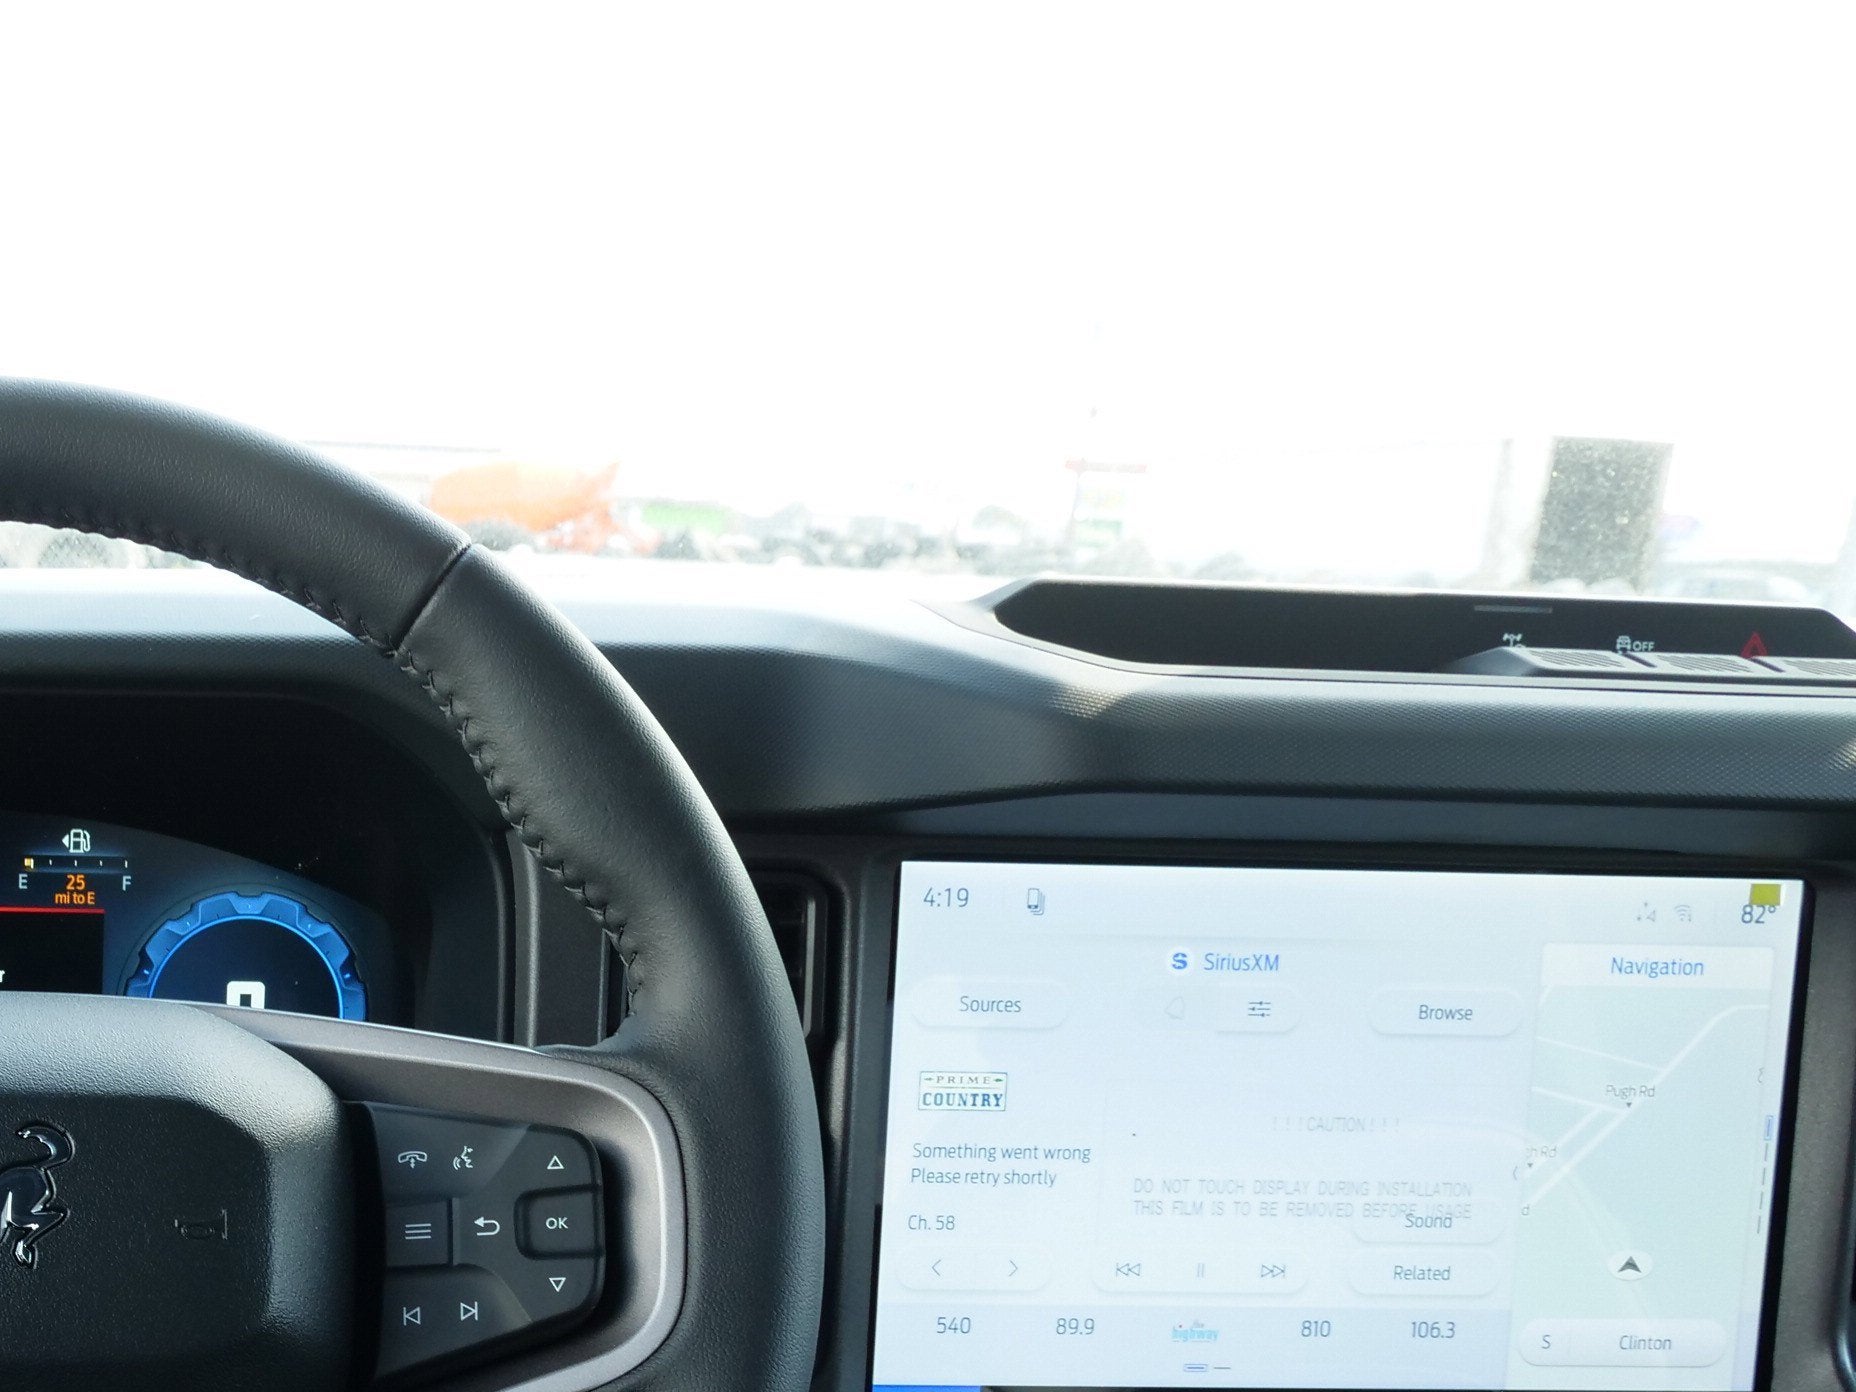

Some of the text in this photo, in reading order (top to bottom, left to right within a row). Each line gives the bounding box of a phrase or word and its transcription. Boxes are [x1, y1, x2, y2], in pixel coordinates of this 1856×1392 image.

[1632, 640, 1655, 652] OFF
[18, 873, 28, 889] E
[65, 874, 86, 890] 25
[121, 875, 132, 891] F
[55, 891, 95, 905] mi to E
[923, 887, 970, 908] 4:19
[1203, 952, 1281, 972] SiriusXM
[1610, 957, 1705, 978] Navigation
[958, 995, 1022, 1014] Sources
[1418, 1003, 1474, 1021] Browse
[935, 1075, 992, 1085] PRIME
[921, 1091, 1004, 1108] COUNTRY
[1605, 1084, 1656, 1099] Pugh Rd
[912, 1143, 1092, 1164] Something went wrong
[910, 1168, 1057, 1189] Please retry shortly
[1133, 1178, 1473, 1198] DO NOT TOUCH DISPLAY DURING INSTALLATION
[1133, 1200, 1164, 1216] THIS
[1171, 1200, 1205, 1217] FILM
[1233, 1201, 1251, 1217] TO
[1258, 1201, 1279, 1217] BE
[1286, 1201, 1355, 1218] REMOVED
[1362, 1202, 1418, 1219] BEFORE
[545, 1217, 569, 1229] OK
[907, 1215, 956, 1232] Ch. 58
[1404, 1212, 1453, 1229] Sound
[1393, 1264, 1452, 1282] Related
[935, 1317, 973, 1335] 540
[1055, 1317, 1095, 1336] 89.9
[1300, 1320, 1332, 1338] 810
[1410, 1321, 1456, 1339] 106.3
[1540, 1335, 1552, 1350] S
[1618, 1334, 1672, 1352] Clinton
